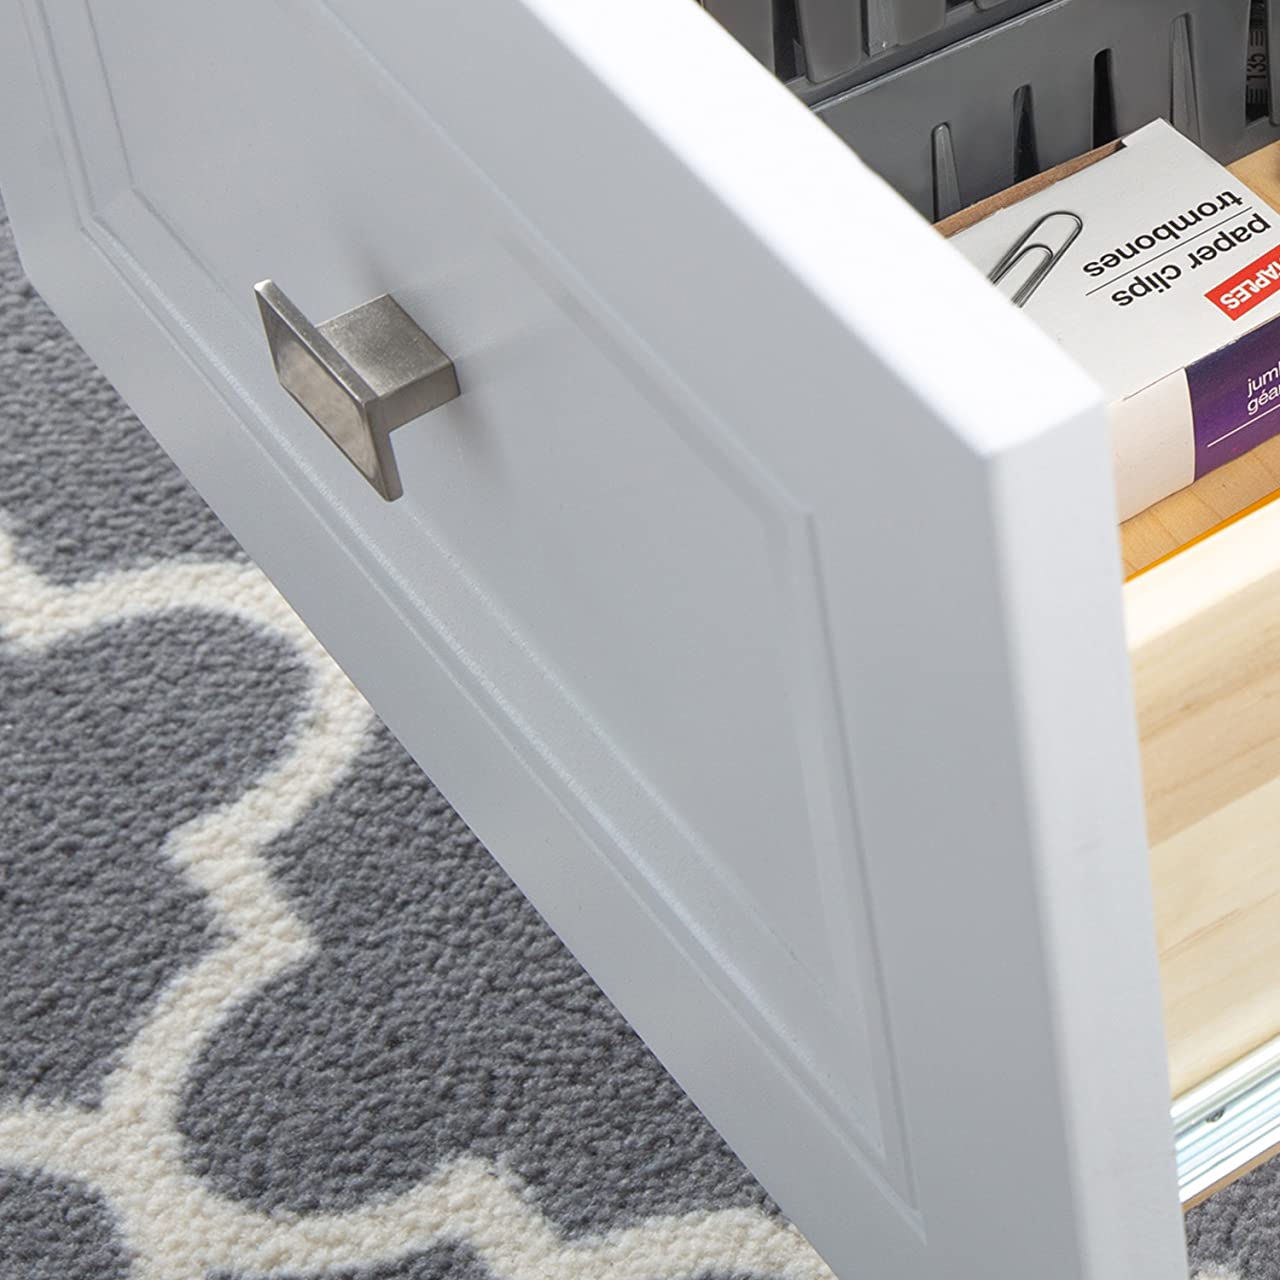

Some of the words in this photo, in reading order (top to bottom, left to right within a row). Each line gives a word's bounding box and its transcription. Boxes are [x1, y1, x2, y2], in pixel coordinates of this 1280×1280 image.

[1083, 191, 1243, 277] trombones
[1190, 213, 1271, 270] paper
[1111, 264, 1182, 307] clips
